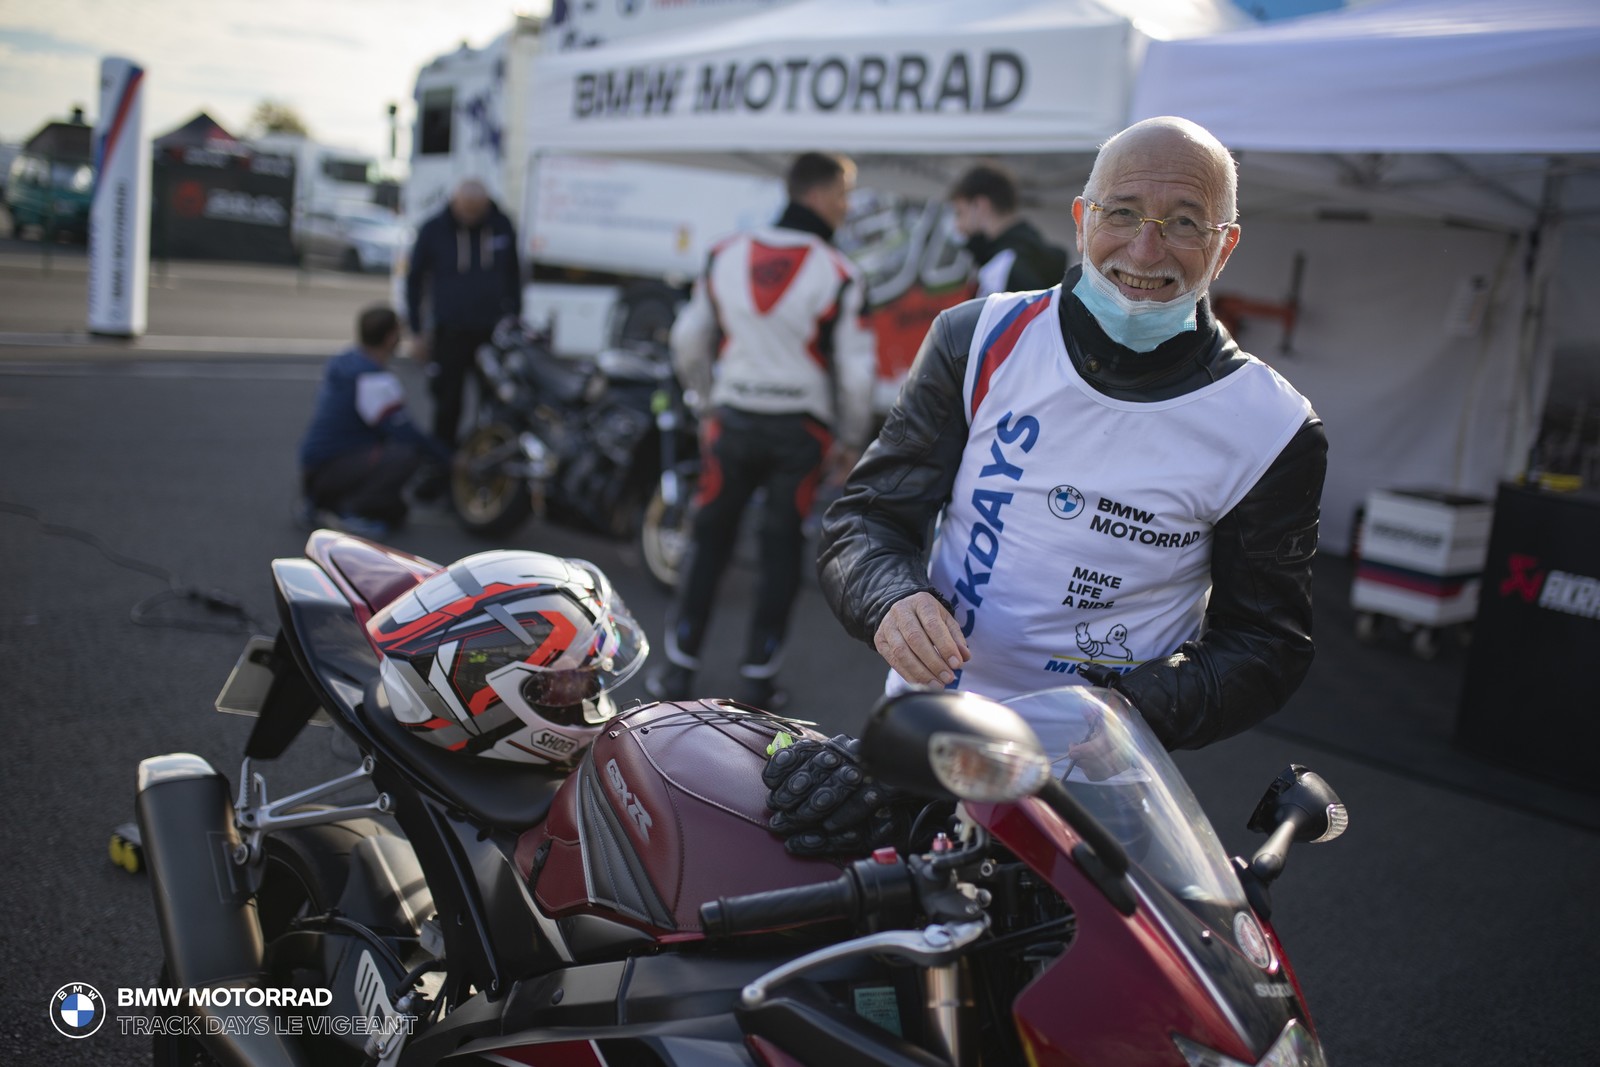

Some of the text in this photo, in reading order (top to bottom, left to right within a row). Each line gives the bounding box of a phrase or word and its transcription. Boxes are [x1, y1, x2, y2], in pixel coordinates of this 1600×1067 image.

[574, 49, 1026, 118] BMW MOTORRAD
[1097, 497, 1155, 524] BMW
[1090, 515, 1200, 548] MOTORRAD
[1072, 566, 1122, 589] MAKE
[1067, 581, 1103, 599] LIFE
[1062, 595, 1115, 610] A RIDE
[536, 732, 576, 754] SHOEI
